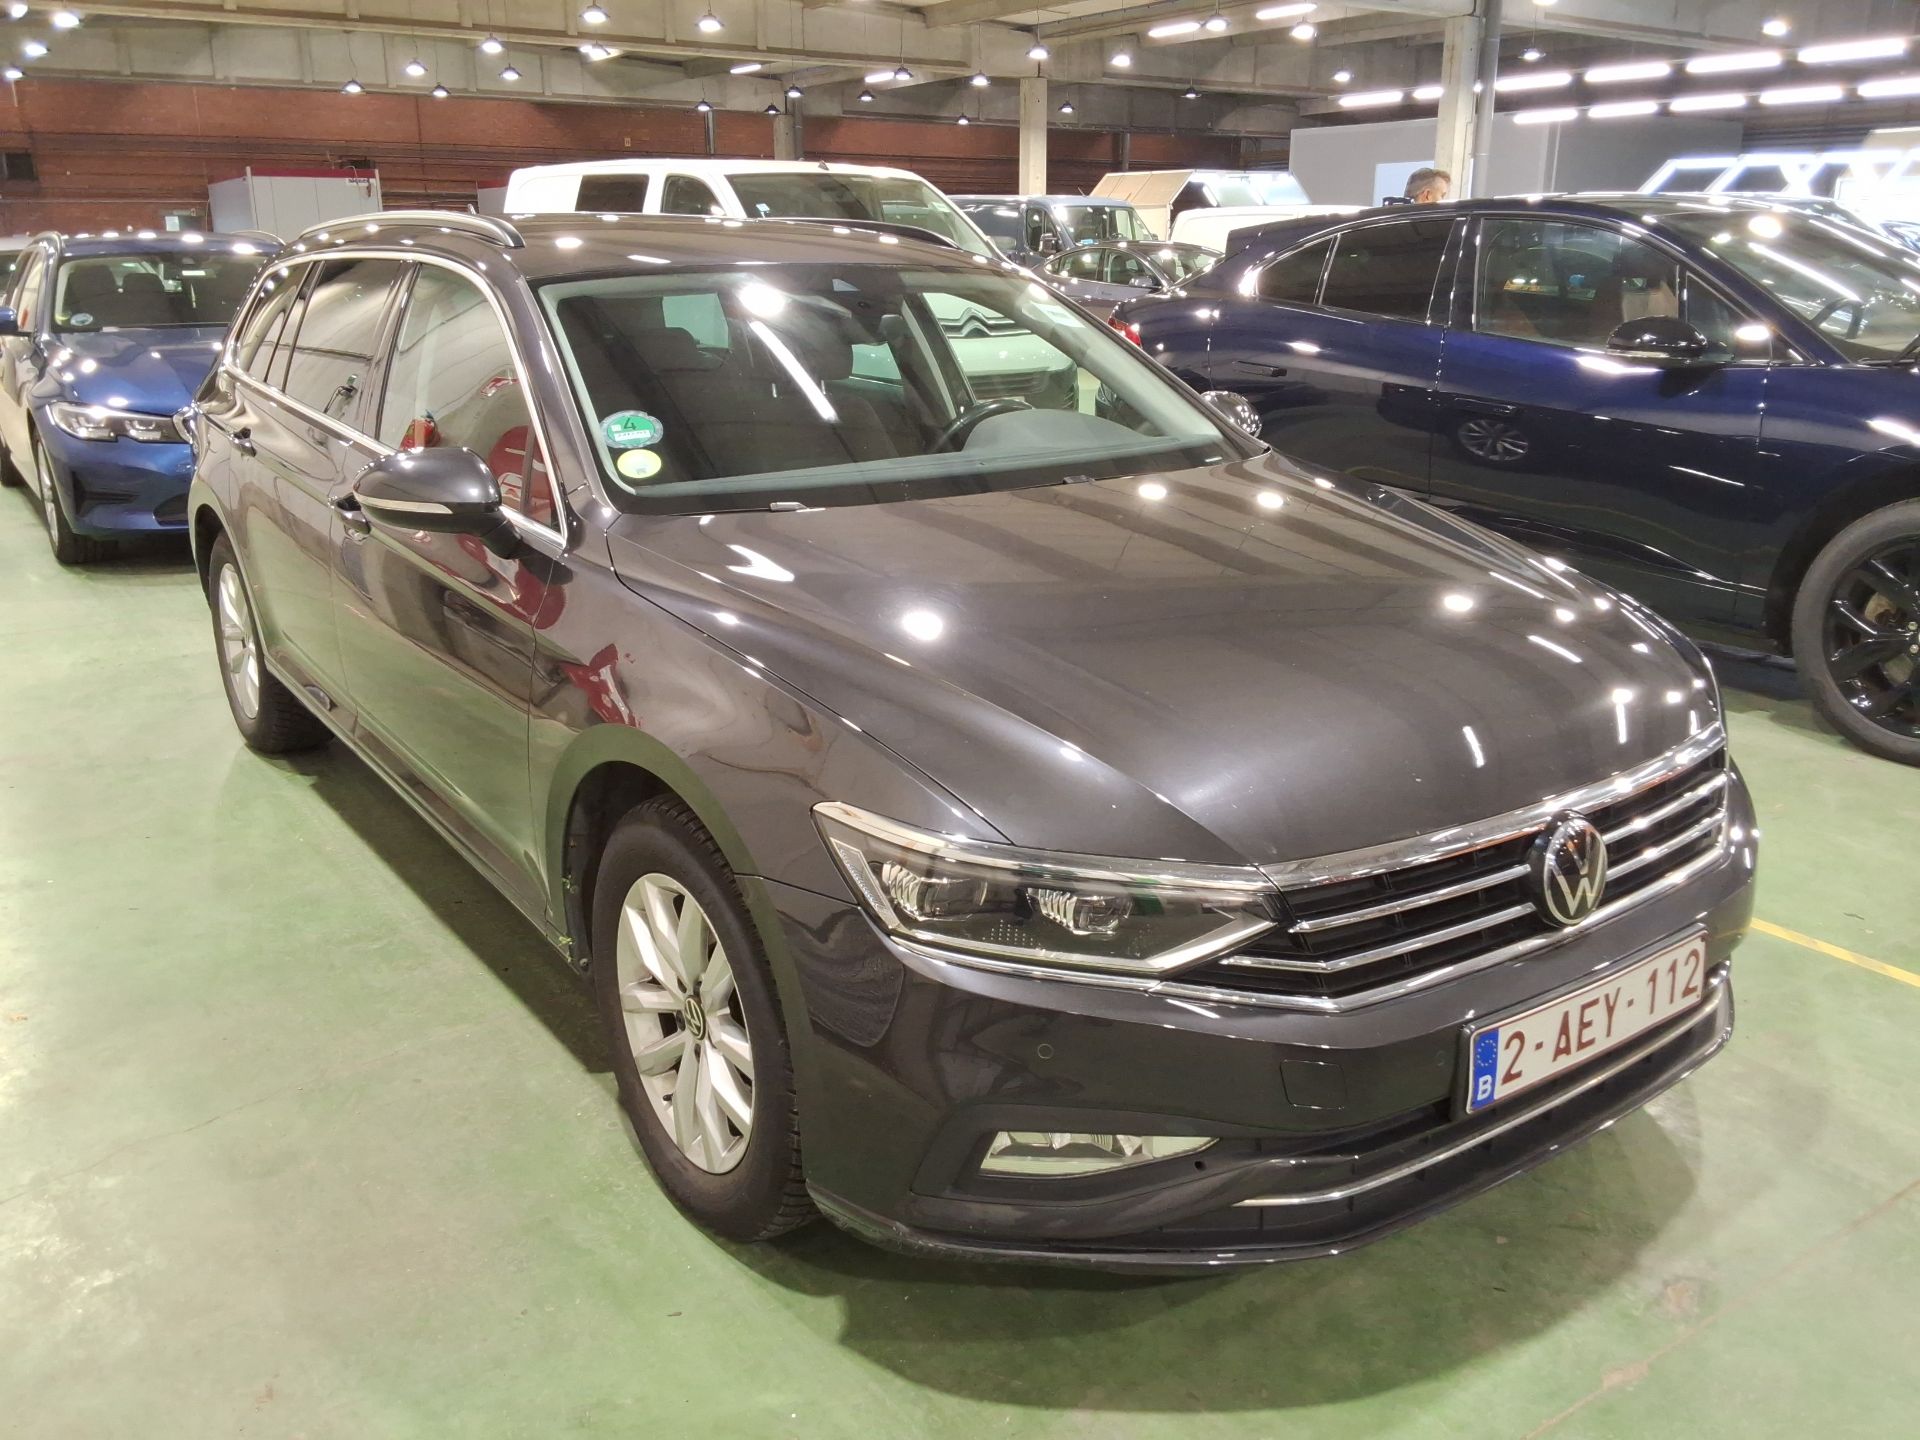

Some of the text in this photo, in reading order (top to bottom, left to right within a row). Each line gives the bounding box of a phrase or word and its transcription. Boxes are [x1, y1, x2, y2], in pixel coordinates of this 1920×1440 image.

[623, 417, 637, 430] 4
[1500, 948, 1700, 1086] 2-AEY-112
[1476, 1075, 1493, 1101] B
